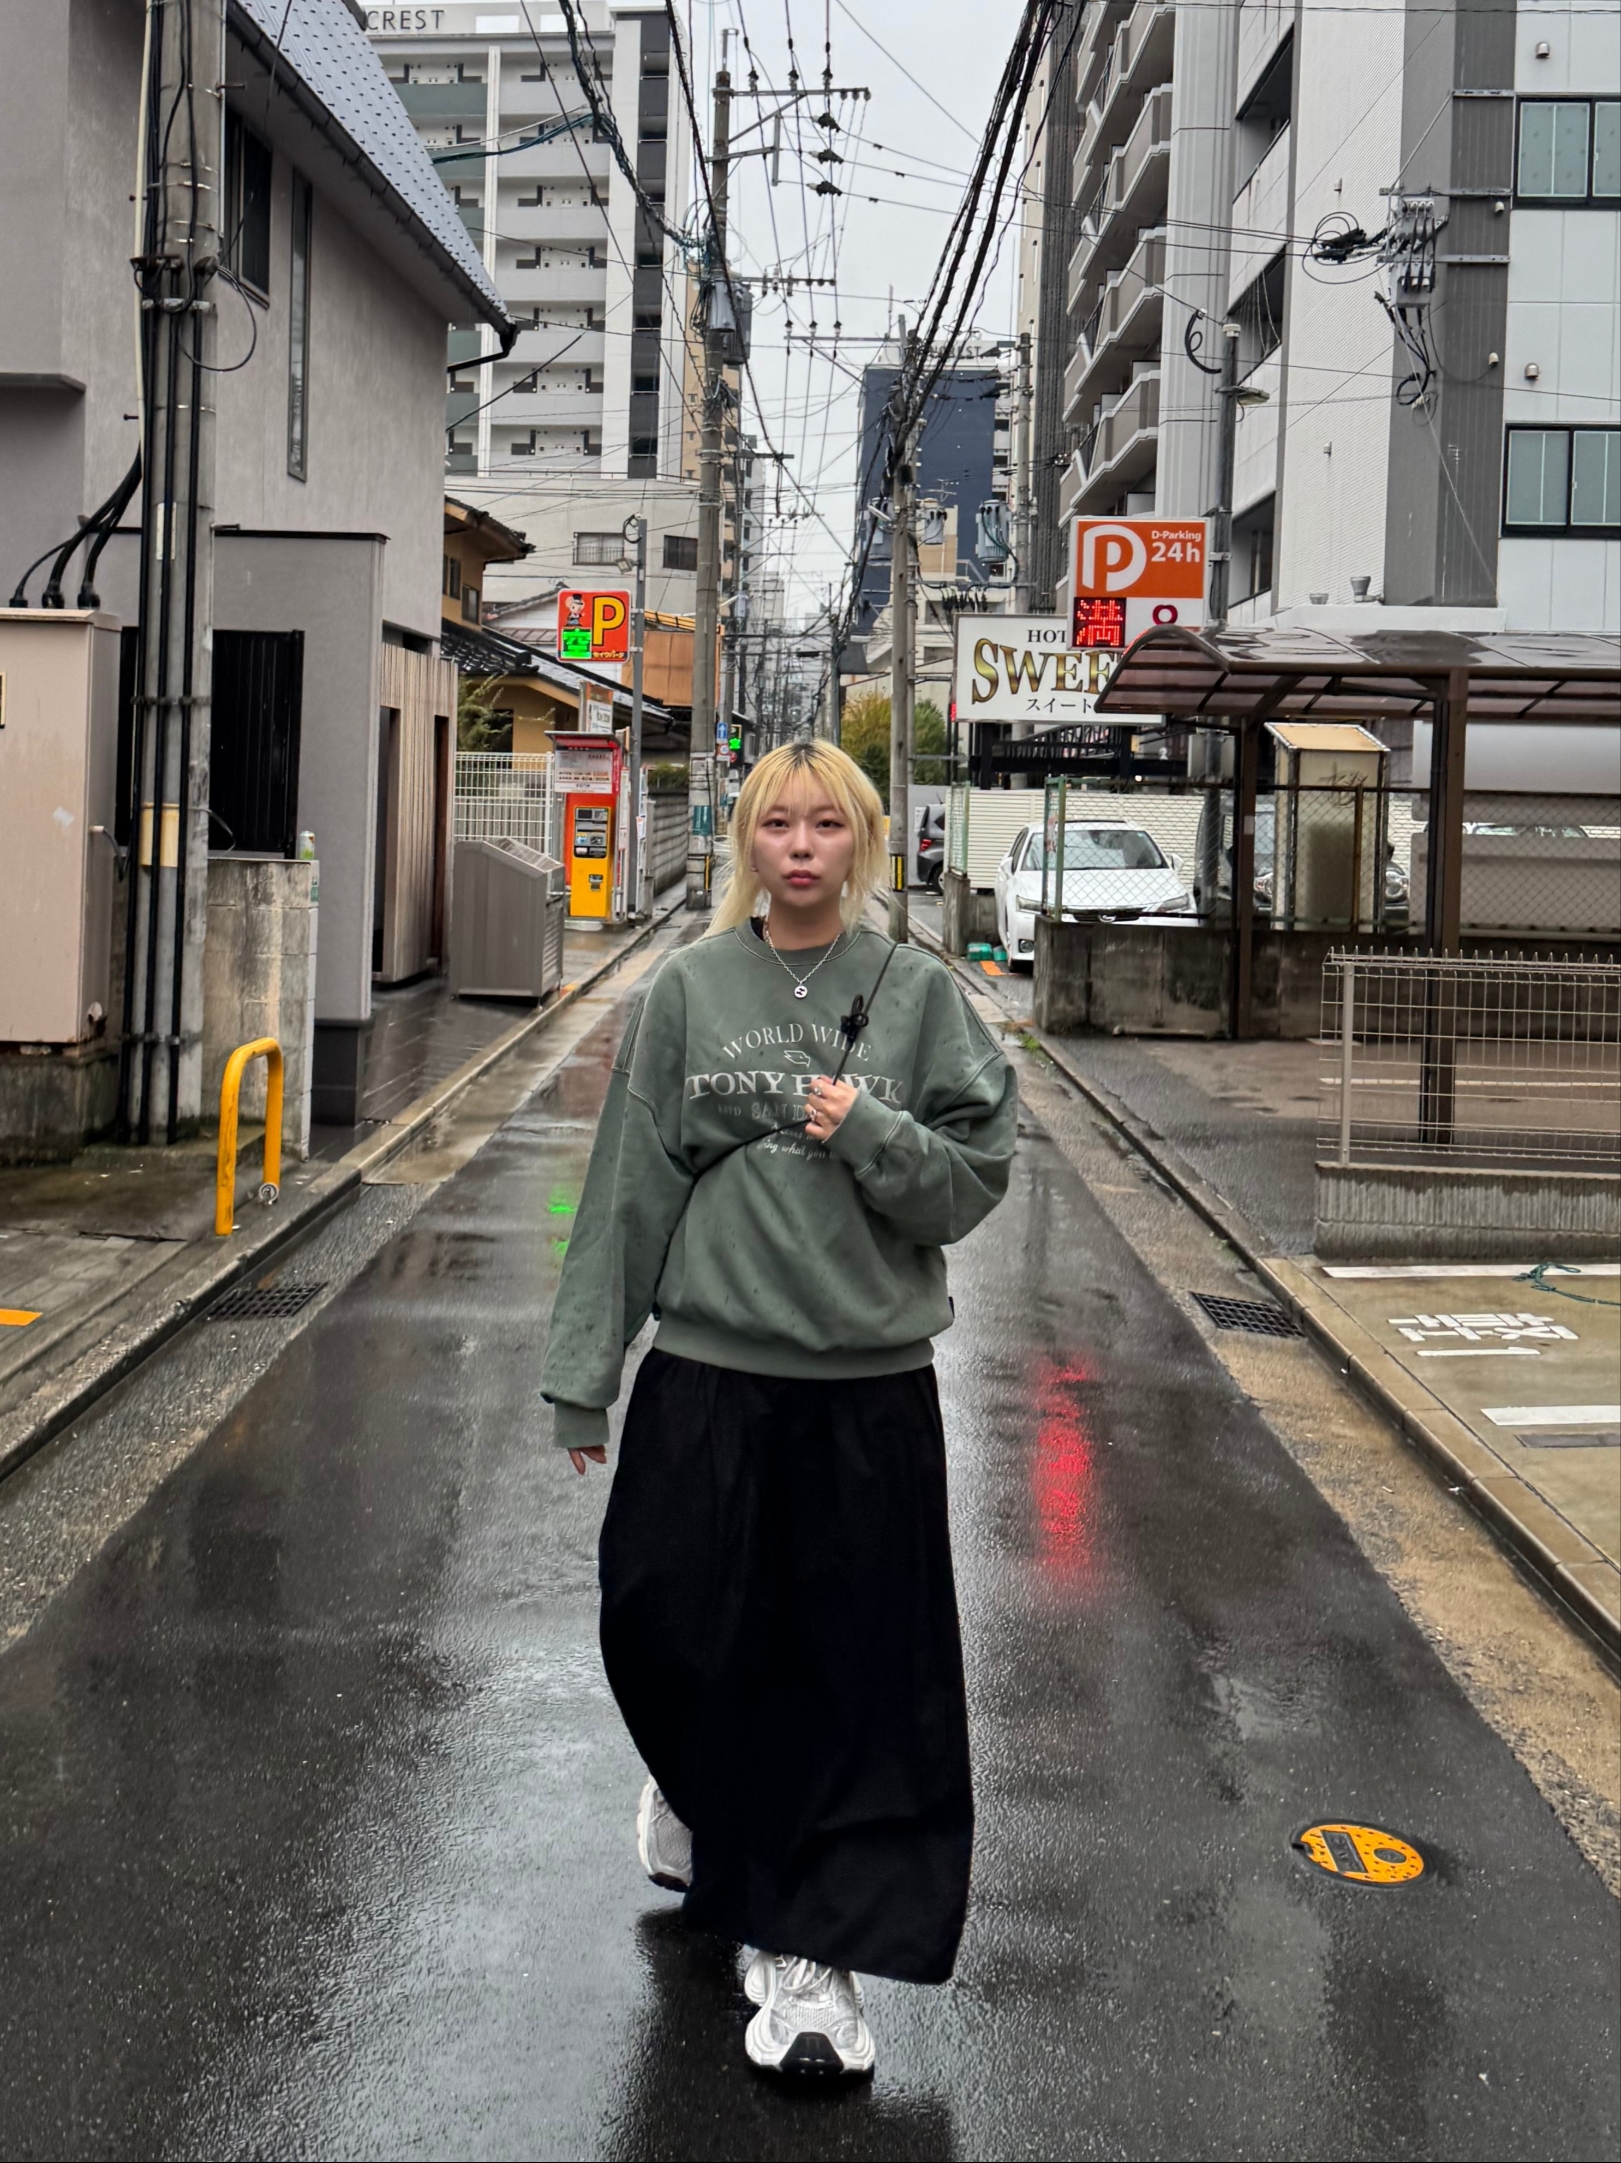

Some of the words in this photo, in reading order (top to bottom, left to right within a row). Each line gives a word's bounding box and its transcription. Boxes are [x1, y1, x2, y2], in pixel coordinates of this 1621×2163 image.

[367, 10, 444, 30] CREST
[1151, 530, 1201, 542] D-Parking
[592, 595, 627, 646] P
[1076, 599, 1123, 646] 満
[562, 628, 591, 658] 空
[971, 637, 1121, 705] SWEE
[1025, 698, 1092, 714] スイート
[722, 1023, 804, 1059] WORLD
[685, 1070, 785, 1100] TONY
[791, 1073, 904, 1104] HWK
